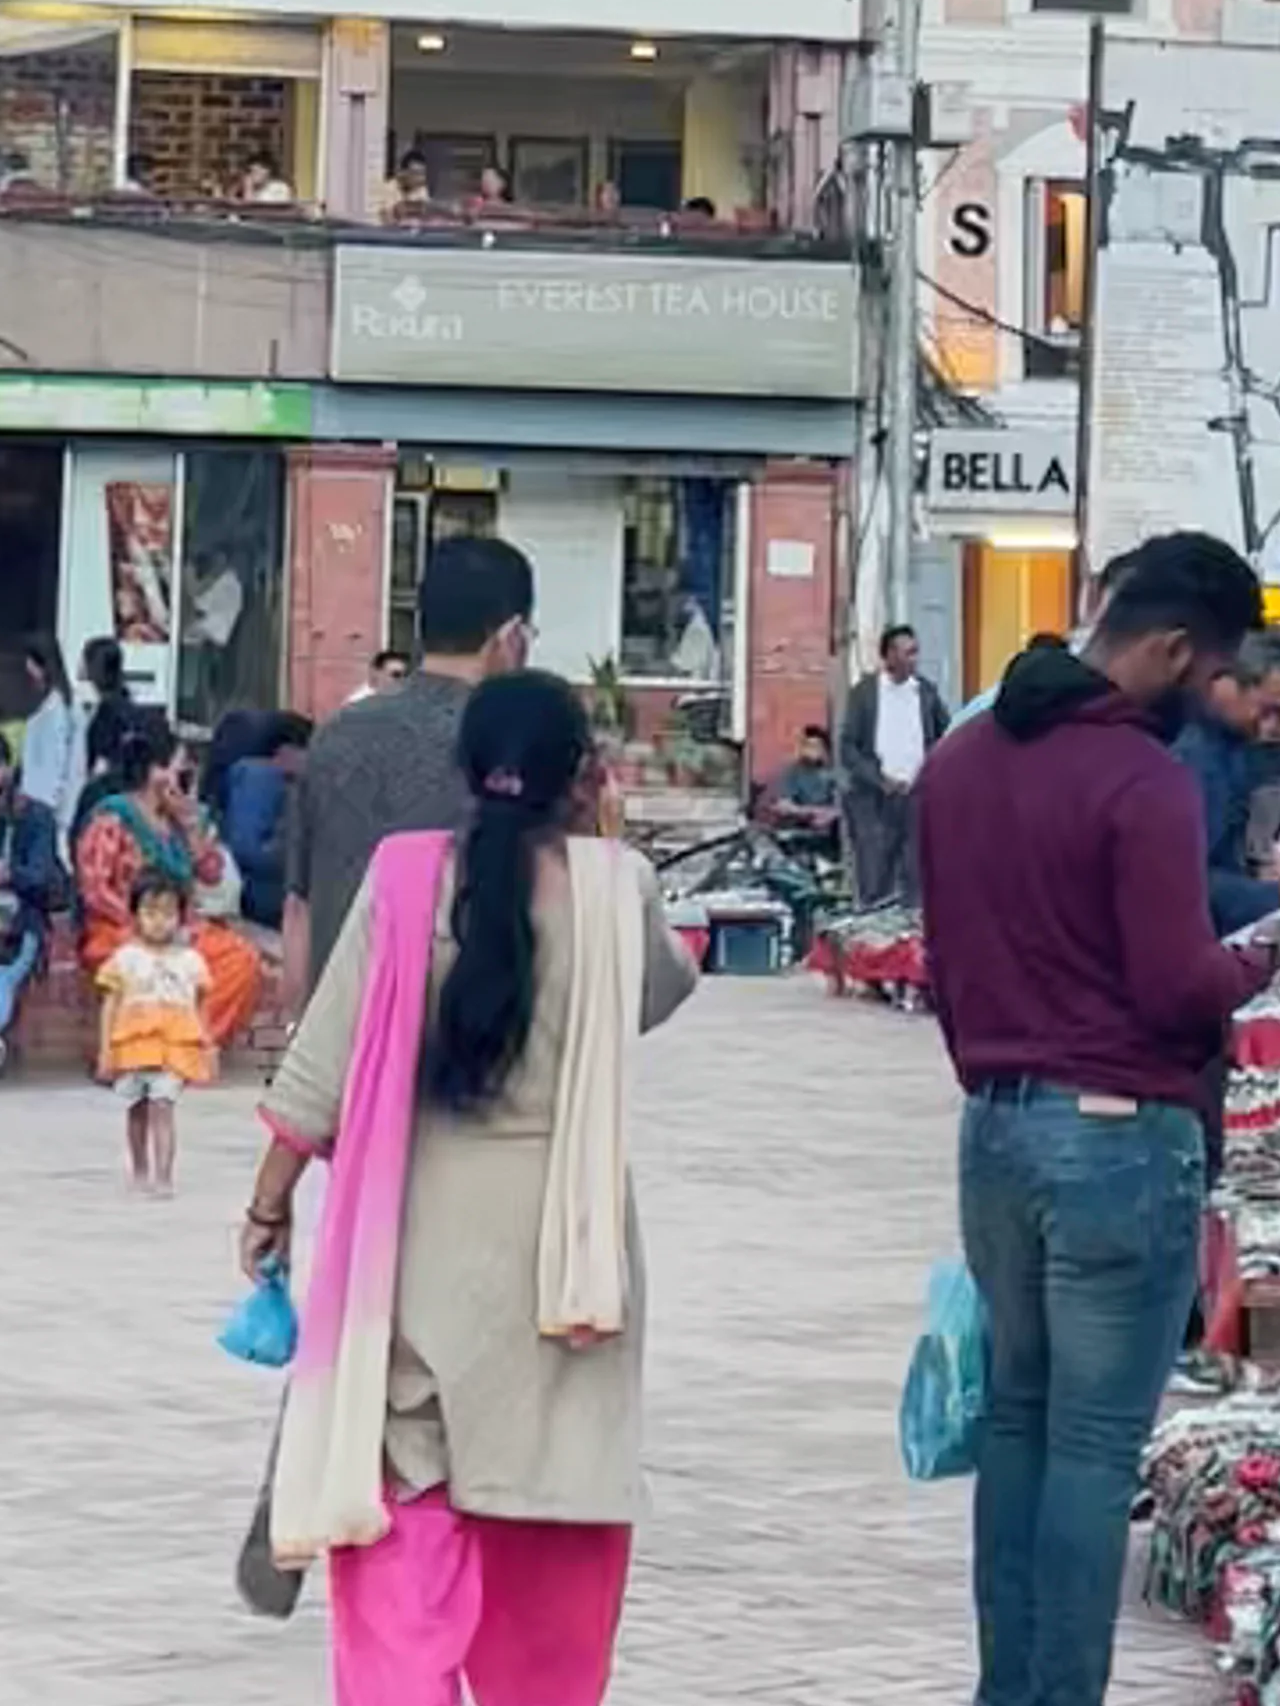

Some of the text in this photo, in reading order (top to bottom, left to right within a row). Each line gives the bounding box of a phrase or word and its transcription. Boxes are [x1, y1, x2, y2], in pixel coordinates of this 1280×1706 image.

[497, 279, 638, 314] EVEREST
[649, 282, 711, 318] TEA
[721, 285, 839, 321] HOUSE
[943, 451, 1070, 492] BELLA
